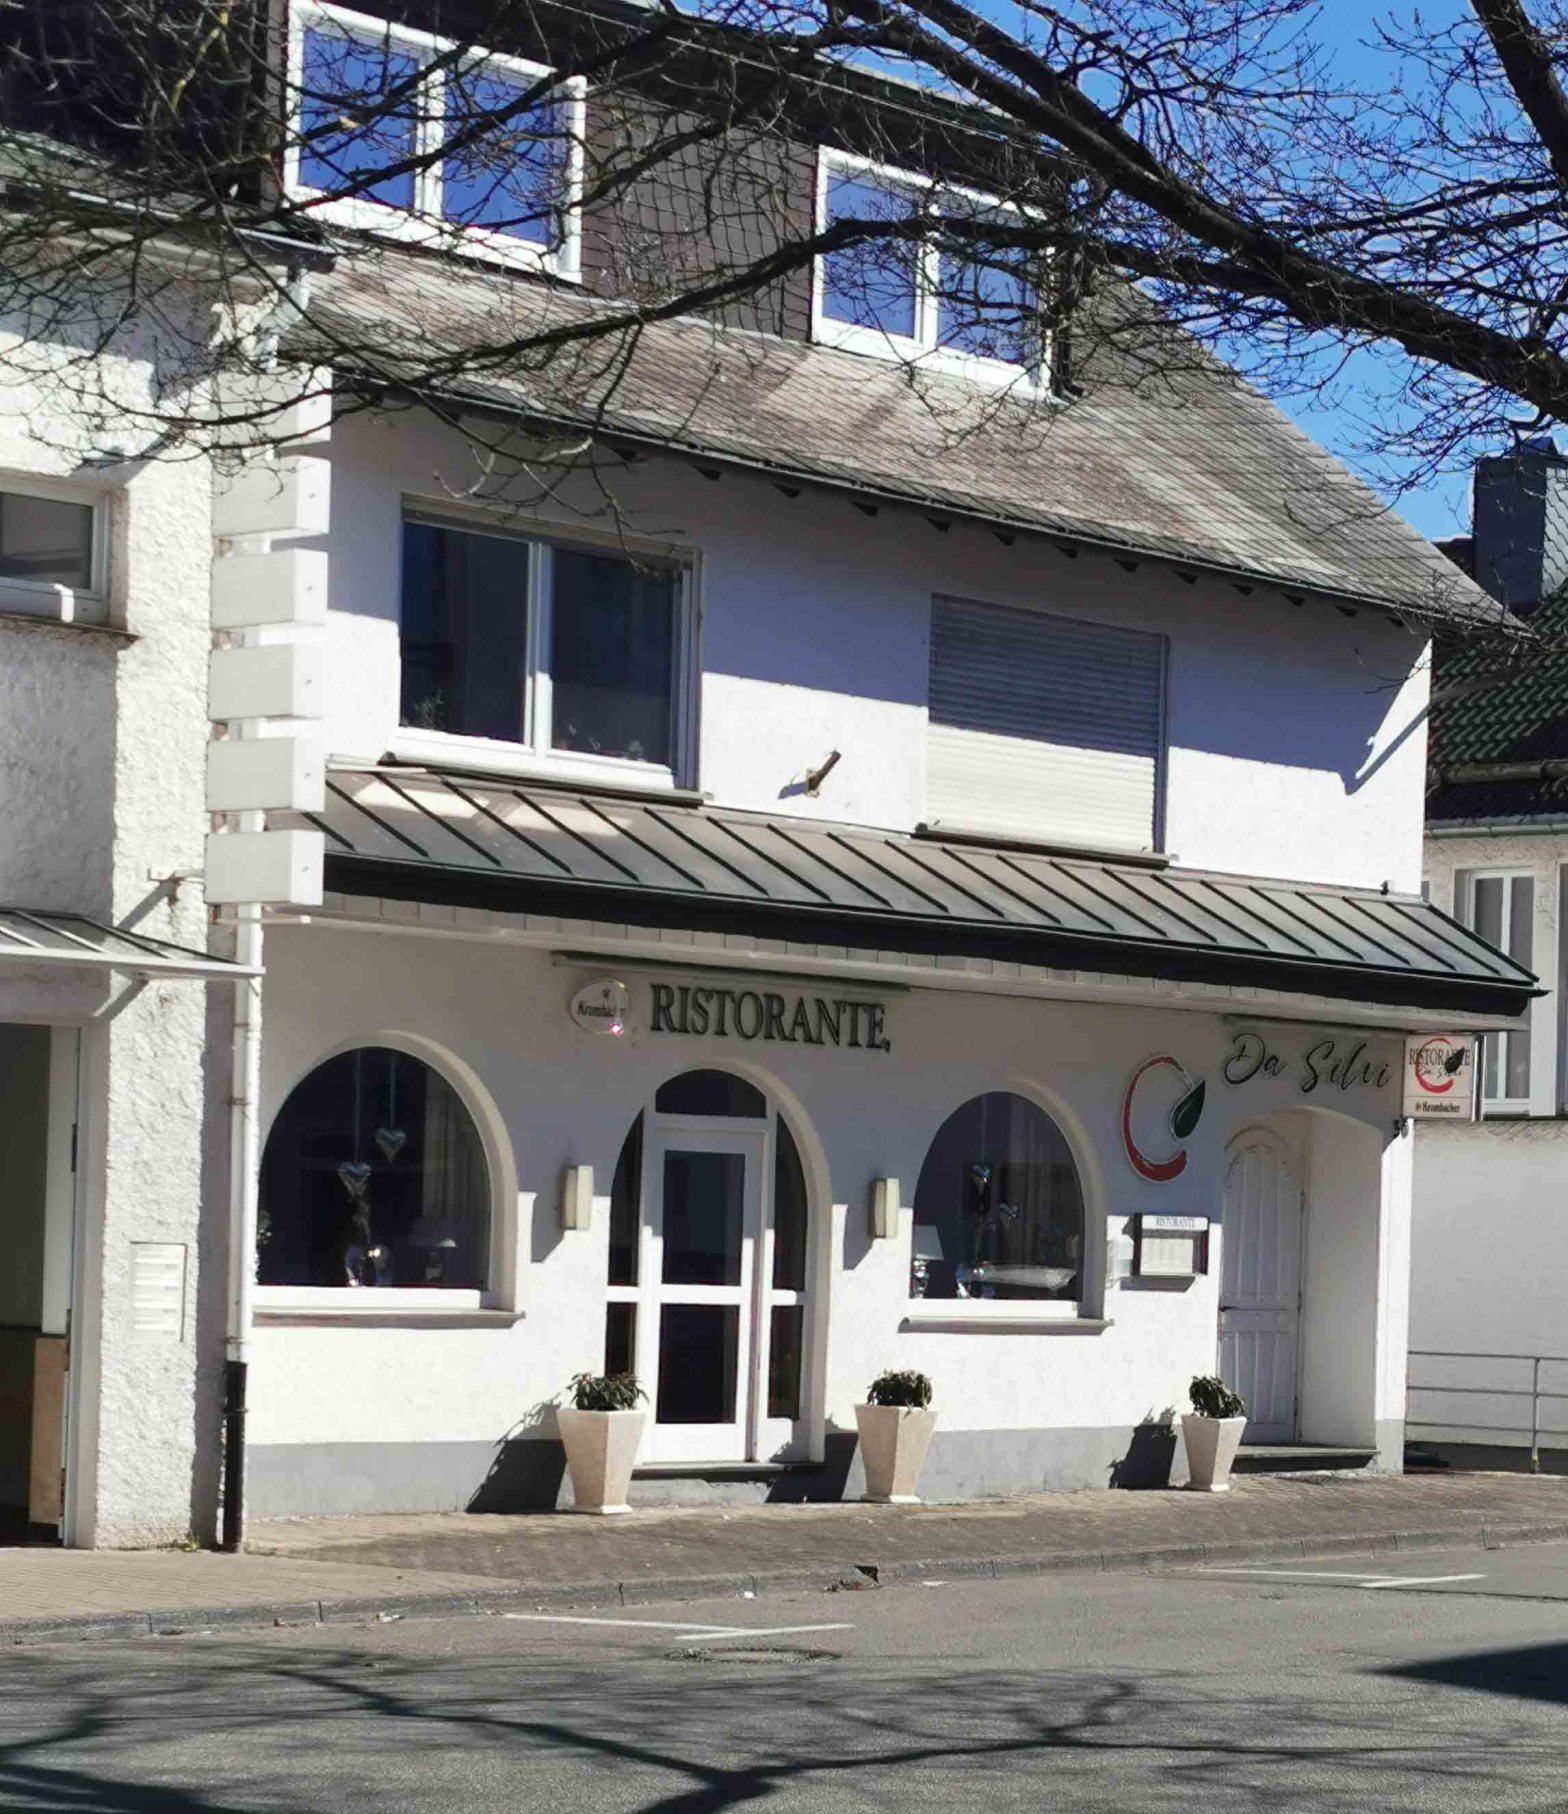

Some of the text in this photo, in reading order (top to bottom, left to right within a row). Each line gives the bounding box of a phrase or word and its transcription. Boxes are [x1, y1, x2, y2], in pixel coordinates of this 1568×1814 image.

[650, 983, 891, 1052] RISTORANTE
[1224, 1033, 1393, 1094] Da Silvi
[1422, 1101, 1461, 1113] Krombacher
